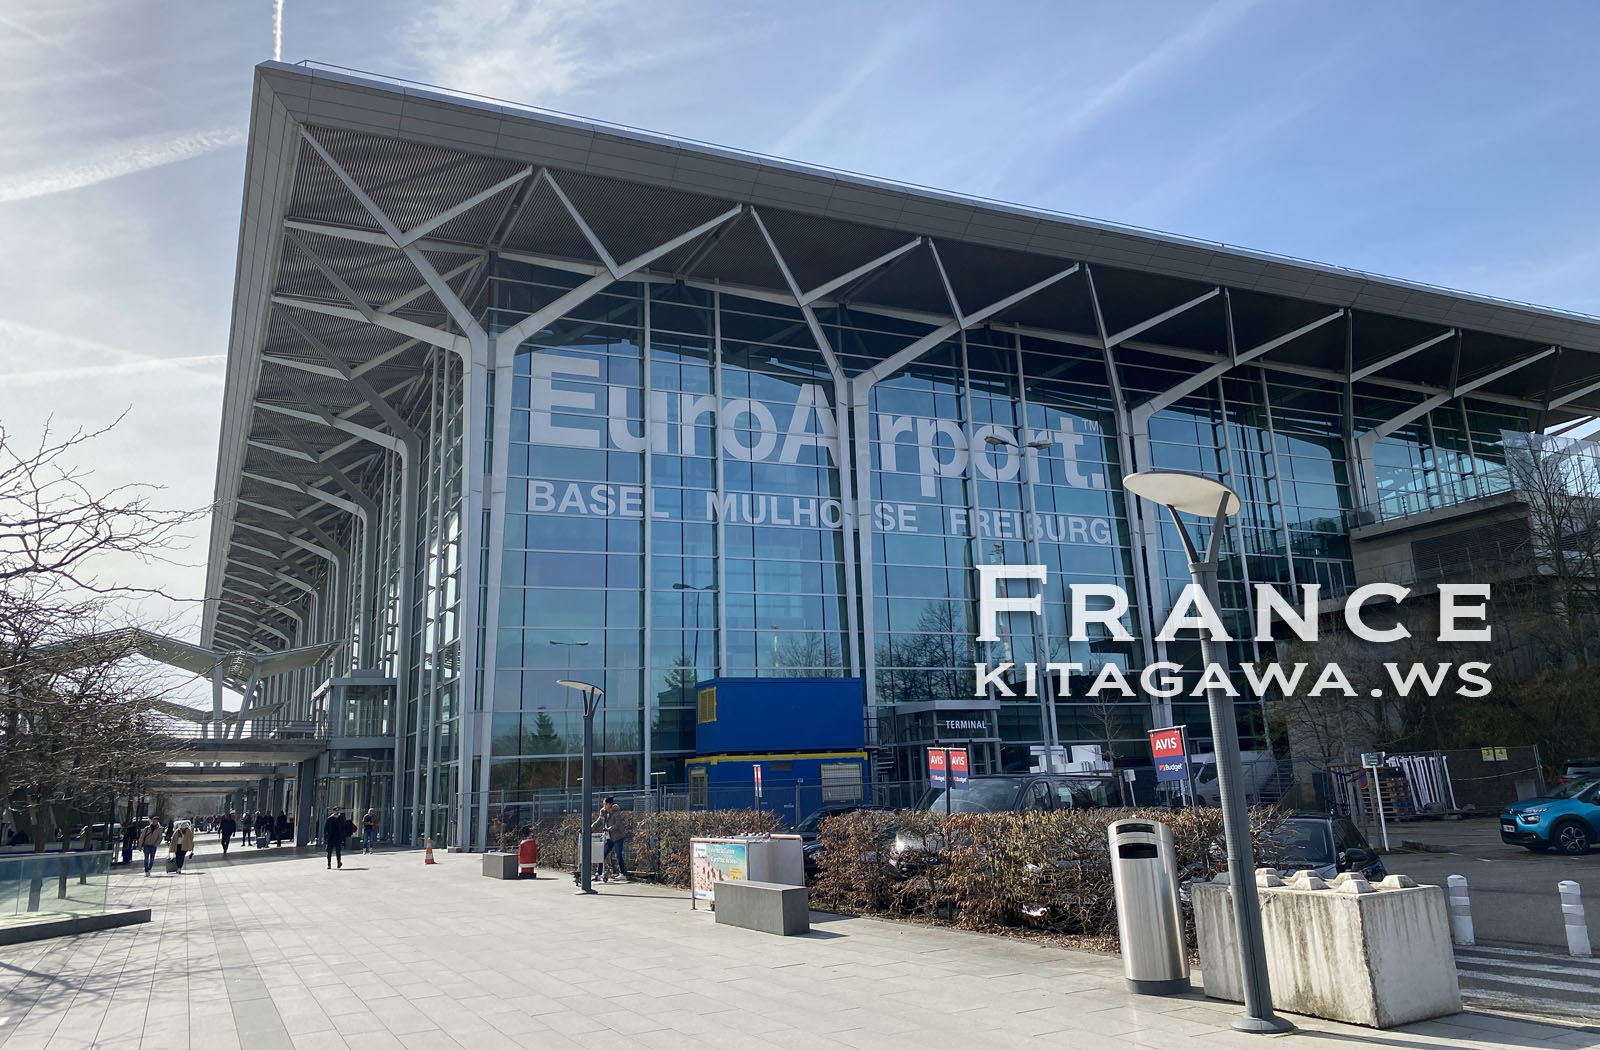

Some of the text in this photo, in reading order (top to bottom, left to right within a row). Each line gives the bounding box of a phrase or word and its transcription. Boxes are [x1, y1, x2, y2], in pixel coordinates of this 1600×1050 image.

[530, 352, 1105, 498] EuroArport.
[528, 481, 1113, 544] BASEL MULHOSE FREIBURG
[945, 720, 986, 729] TERMINAL
[1155, 737, 1177, 750] AVIS
[930, 755, 943, 765] AVIS
[951, 756, 965, 766] AVIS
[1164, 763, 1183, 772] Budget
